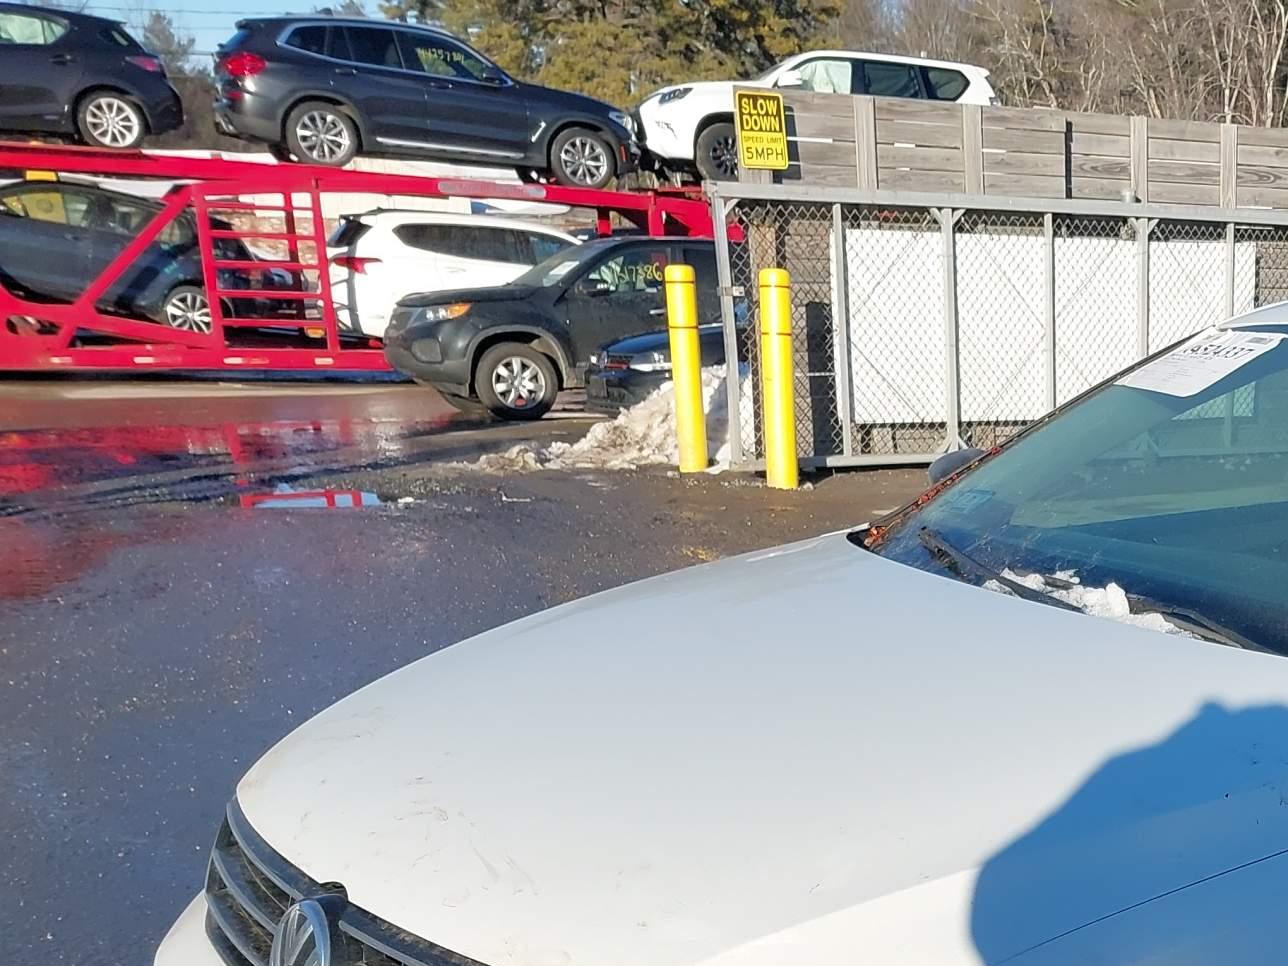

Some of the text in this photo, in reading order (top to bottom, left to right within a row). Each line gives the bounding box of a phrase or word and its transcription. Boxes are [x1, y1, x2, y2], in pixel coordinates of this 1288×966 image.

[741, 98, 778, 116] SLOW
[742, 114, 780, 131] DOWN
[743, 135, 782, 145] SPEED LIMIT
[746, 146, 784, 161] 5MPH
